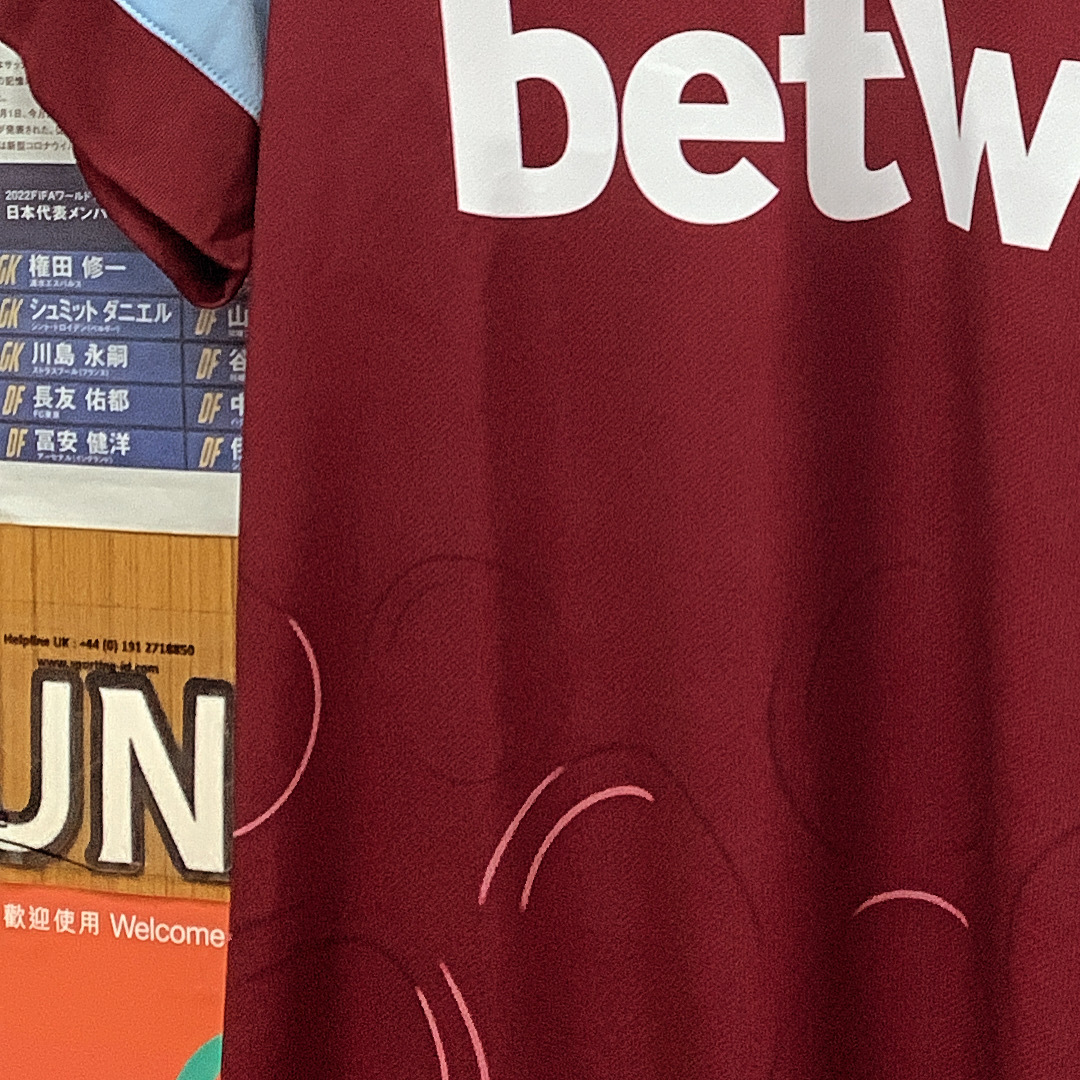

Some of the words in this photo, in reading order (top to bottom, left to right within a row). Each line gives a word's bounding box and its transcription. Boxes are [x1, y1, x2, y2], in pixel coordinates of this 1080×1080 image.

[0, 254, 23, 286] GK
[28, 253, 73, 278] 権田
[81, 255, 127, 280] 修一
[0, 297, 24, 329] GK
[29, 298, 99, 323] シュミット
[102, 299, 173, 324] ダニエル
[0, 341, 26, 373] GK
[31, 341, 75, 367] 川島
[84, 343, 129, 369] 永嗣
[195, 347, 222, 380] DF
[2, 384, 26, 416] DF
[33, 385, 77, 411] 長友
[85, 387, 131, 412] 佑都
[197, 392, 224, 425] DF
[6, 427, 29, 458] DF
[86, 431, 131, 457] 健洋
[198, 436, 225, 469] DF
[4, 633, 49, 648] Helpline
[53, 637, 69, 648] UK
[122, 641, 141, 653] 191
[3, 903, 99, 936] 歡迎使用
[110, 913, 226, 948] Welcome
